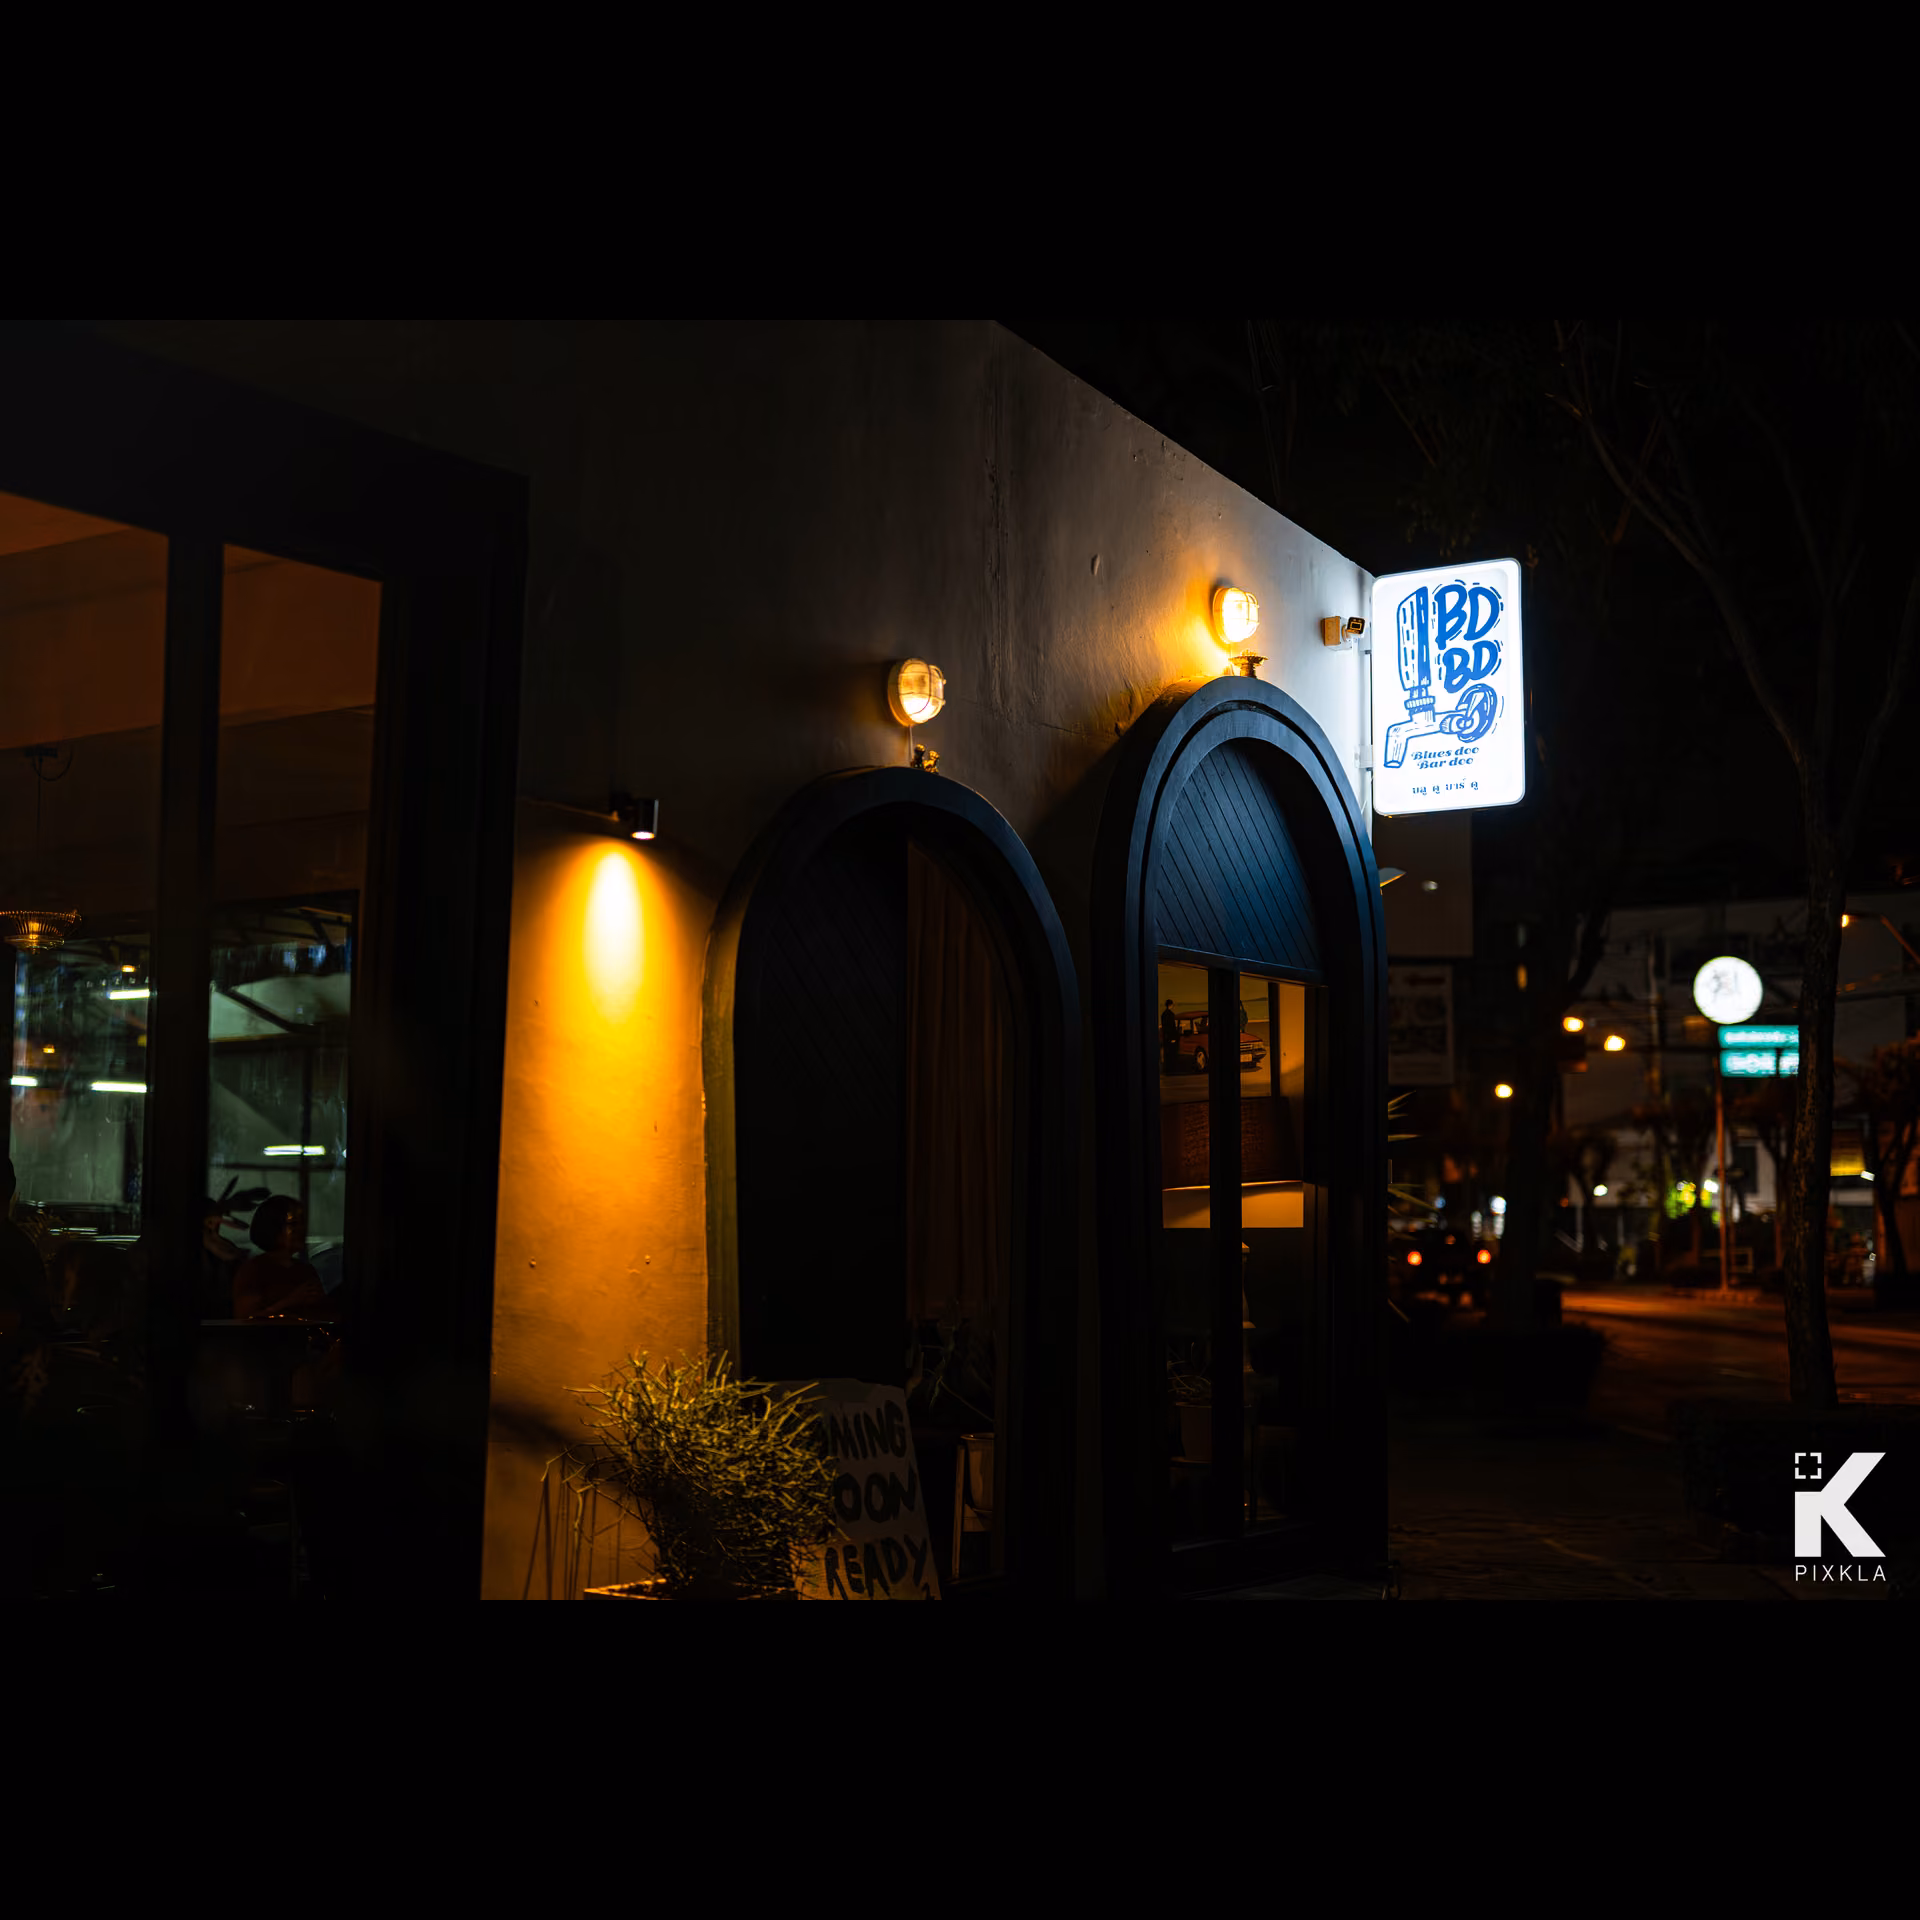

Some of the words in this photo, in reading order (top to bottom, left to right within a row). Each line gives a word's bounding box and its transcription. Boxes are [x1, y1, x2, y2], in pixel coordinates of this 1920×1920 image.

[1434, 583, 1501, 651] BD
[1442, 640, 1499, 694] BD
[1411, 749, 1452, 761] Blues
[1454, 746, 1480, 756] doo
[1417, 760, 1447, 770] Bar
[1448, 757, 1474, 767] doo
[829, 1400, 906, 1460] MING
[833, 1463, 917, 1524] OON
[824, 1534, 928, 1600] READY
